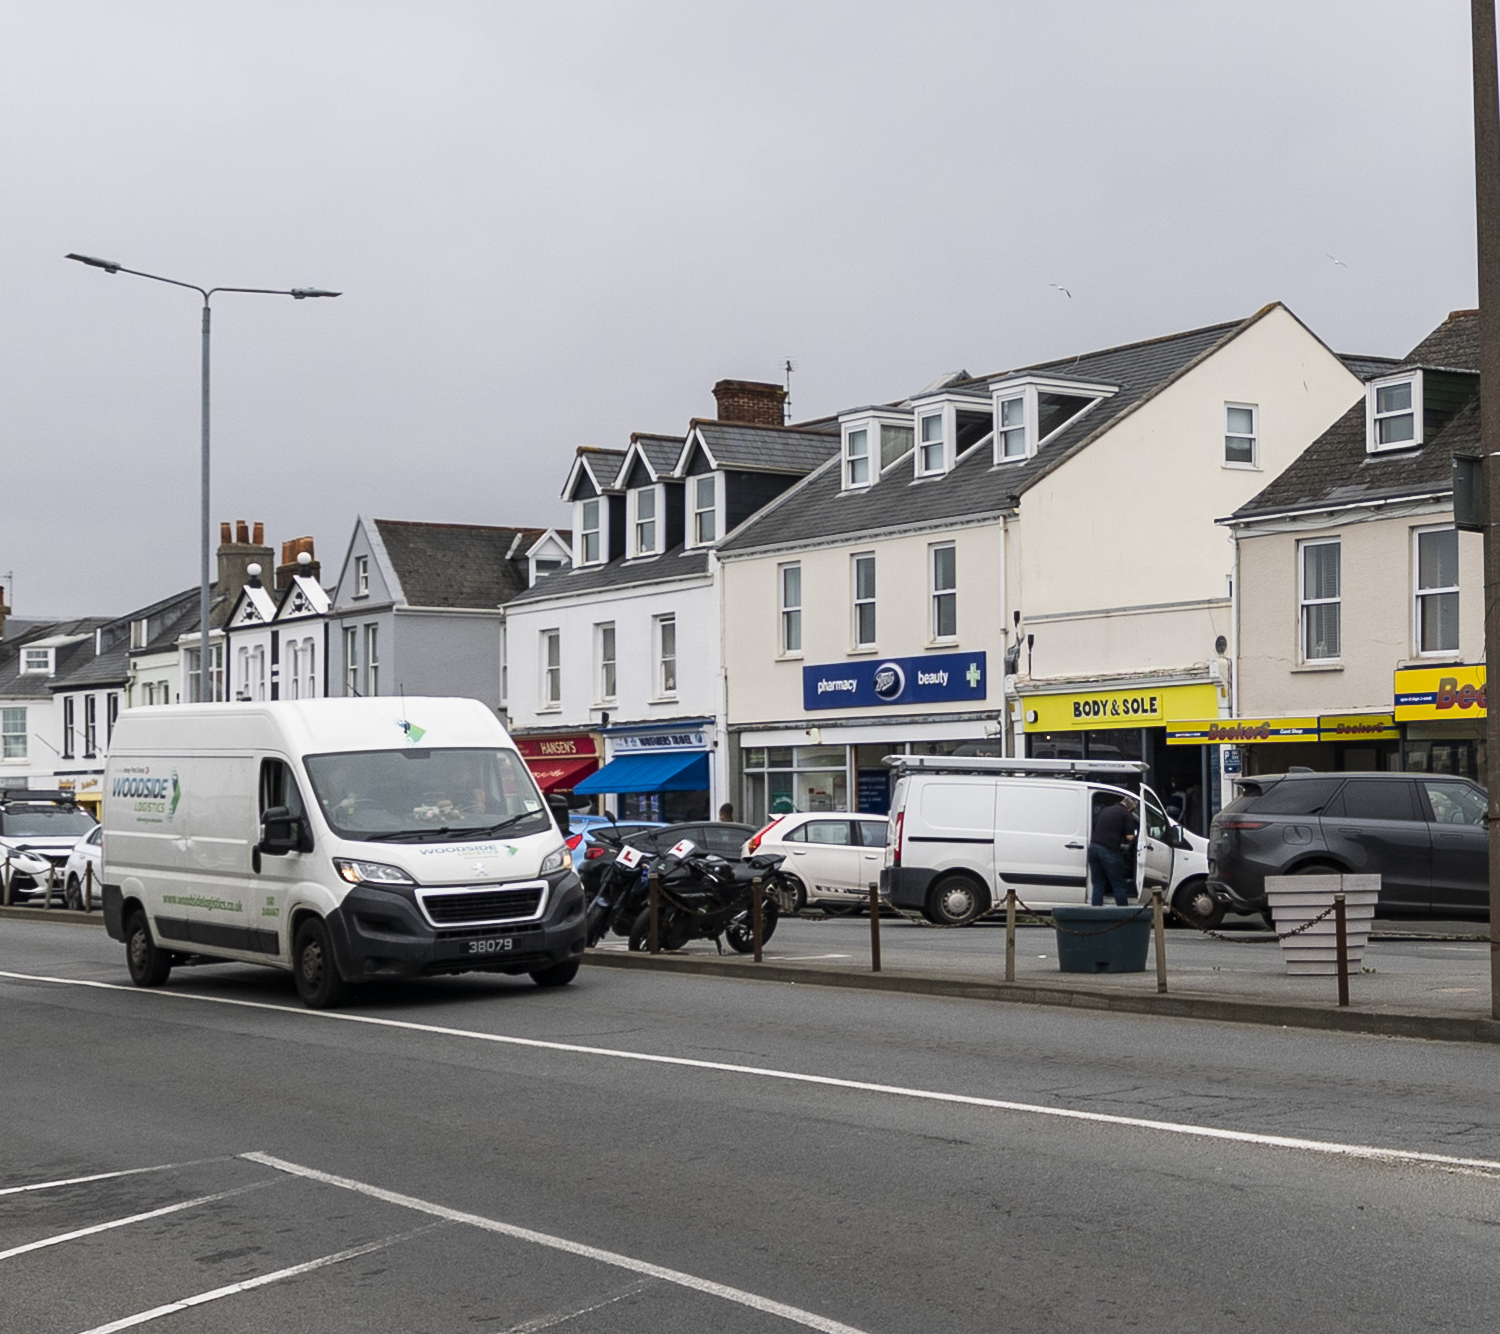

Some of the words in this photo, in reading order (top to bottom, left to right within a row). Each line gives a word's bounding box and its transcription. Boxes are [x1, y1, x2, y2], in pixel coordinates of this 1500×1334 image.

[817, 678, 857, 695] pharmacy
[875, 671, 895, 691] Boots
[918, 670, 948, 686] beauty
[1072, 700, 1109, 718] BODY
[1110, 699, 1121, 716] &
[1122, 696, 1158, 715] SOLE
[540, 741, 577, 755] HANSEN'S
[113, 777, 168, 799] WOODSIDE
[419, 845, 498, 855] WOODSIDE
[675, 842, 683, 852] L
[623, 850, 633, 862] L
[468, 938, 513, 954] 38079
